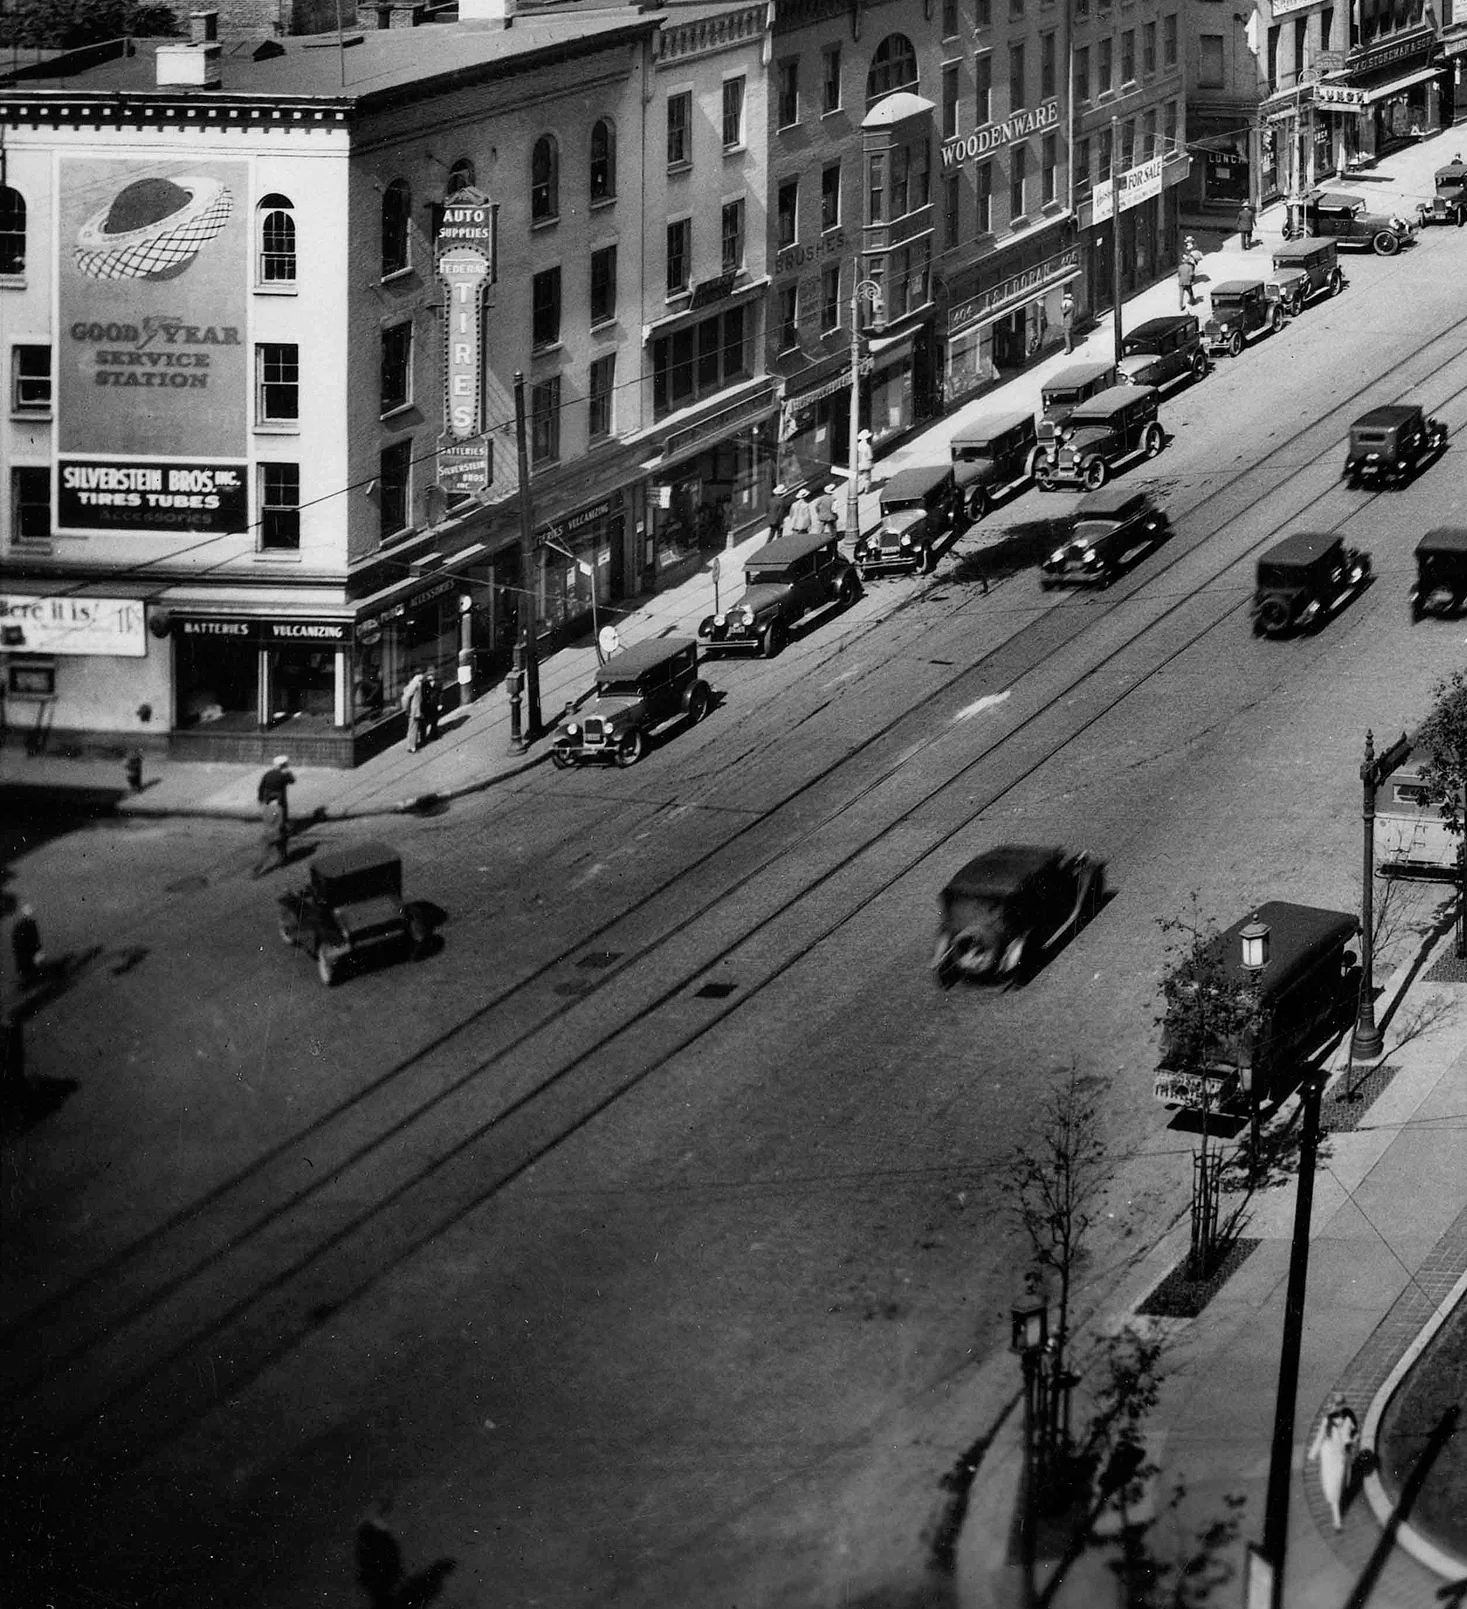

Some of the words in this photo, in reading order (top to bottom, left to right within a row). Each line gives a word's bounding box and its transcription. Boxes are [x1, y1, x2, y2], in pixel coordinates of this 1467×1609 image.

[941, 101, 1058, 167] WOODENWARE
[1128, 172, 1144, 190] FOR
[1144, 161, 1161, 183] SALE
[443, 210, 485, 222] AUTO
[439, 228, 489, 238] SUPPLIES
[775, 233, 845, 274] BRUSHES
[96, 350, 210, 368] SERVICE
[453, 282, 474, 428] TIRES
[95, 370, 209, 389] STATION
[440, 446, 485, 456] BATTERIES
[63, 467, 162, 491] SILVERSTEIN
[169, 469, 217, 493] BROS.
[78, 492, 141, 507] TIRES
[146, 494, 220, 510] TUBES
[568, 502, 609, 531] VULCANIZING
[184, 623, 249, 635] BATTERIES
[273, 625, 343, 638] VULCANIZING
